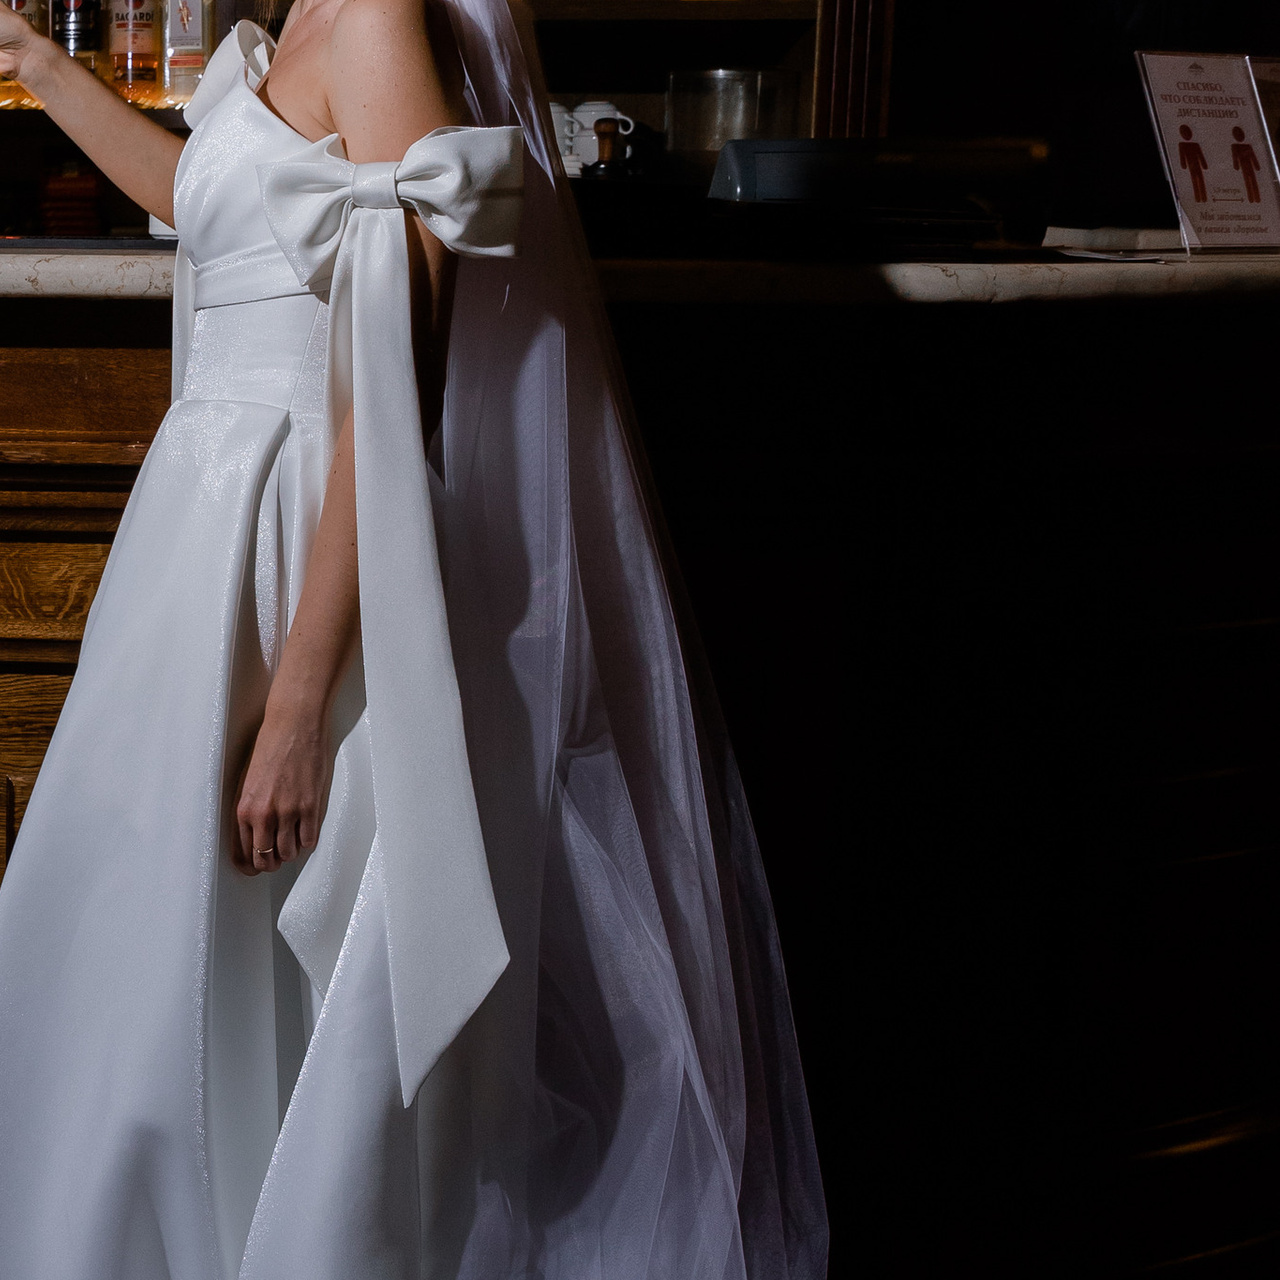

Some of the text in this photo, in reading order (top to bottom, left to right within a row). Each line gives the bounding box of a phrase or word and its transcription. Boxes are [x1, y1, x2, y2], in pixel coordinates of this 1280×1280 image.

[1160, 94, 1247, 106] ЧТО СОБЛЮДАЕТЕ
[1176, 108, 1239, 119] ДИСТАНЦИЮ
